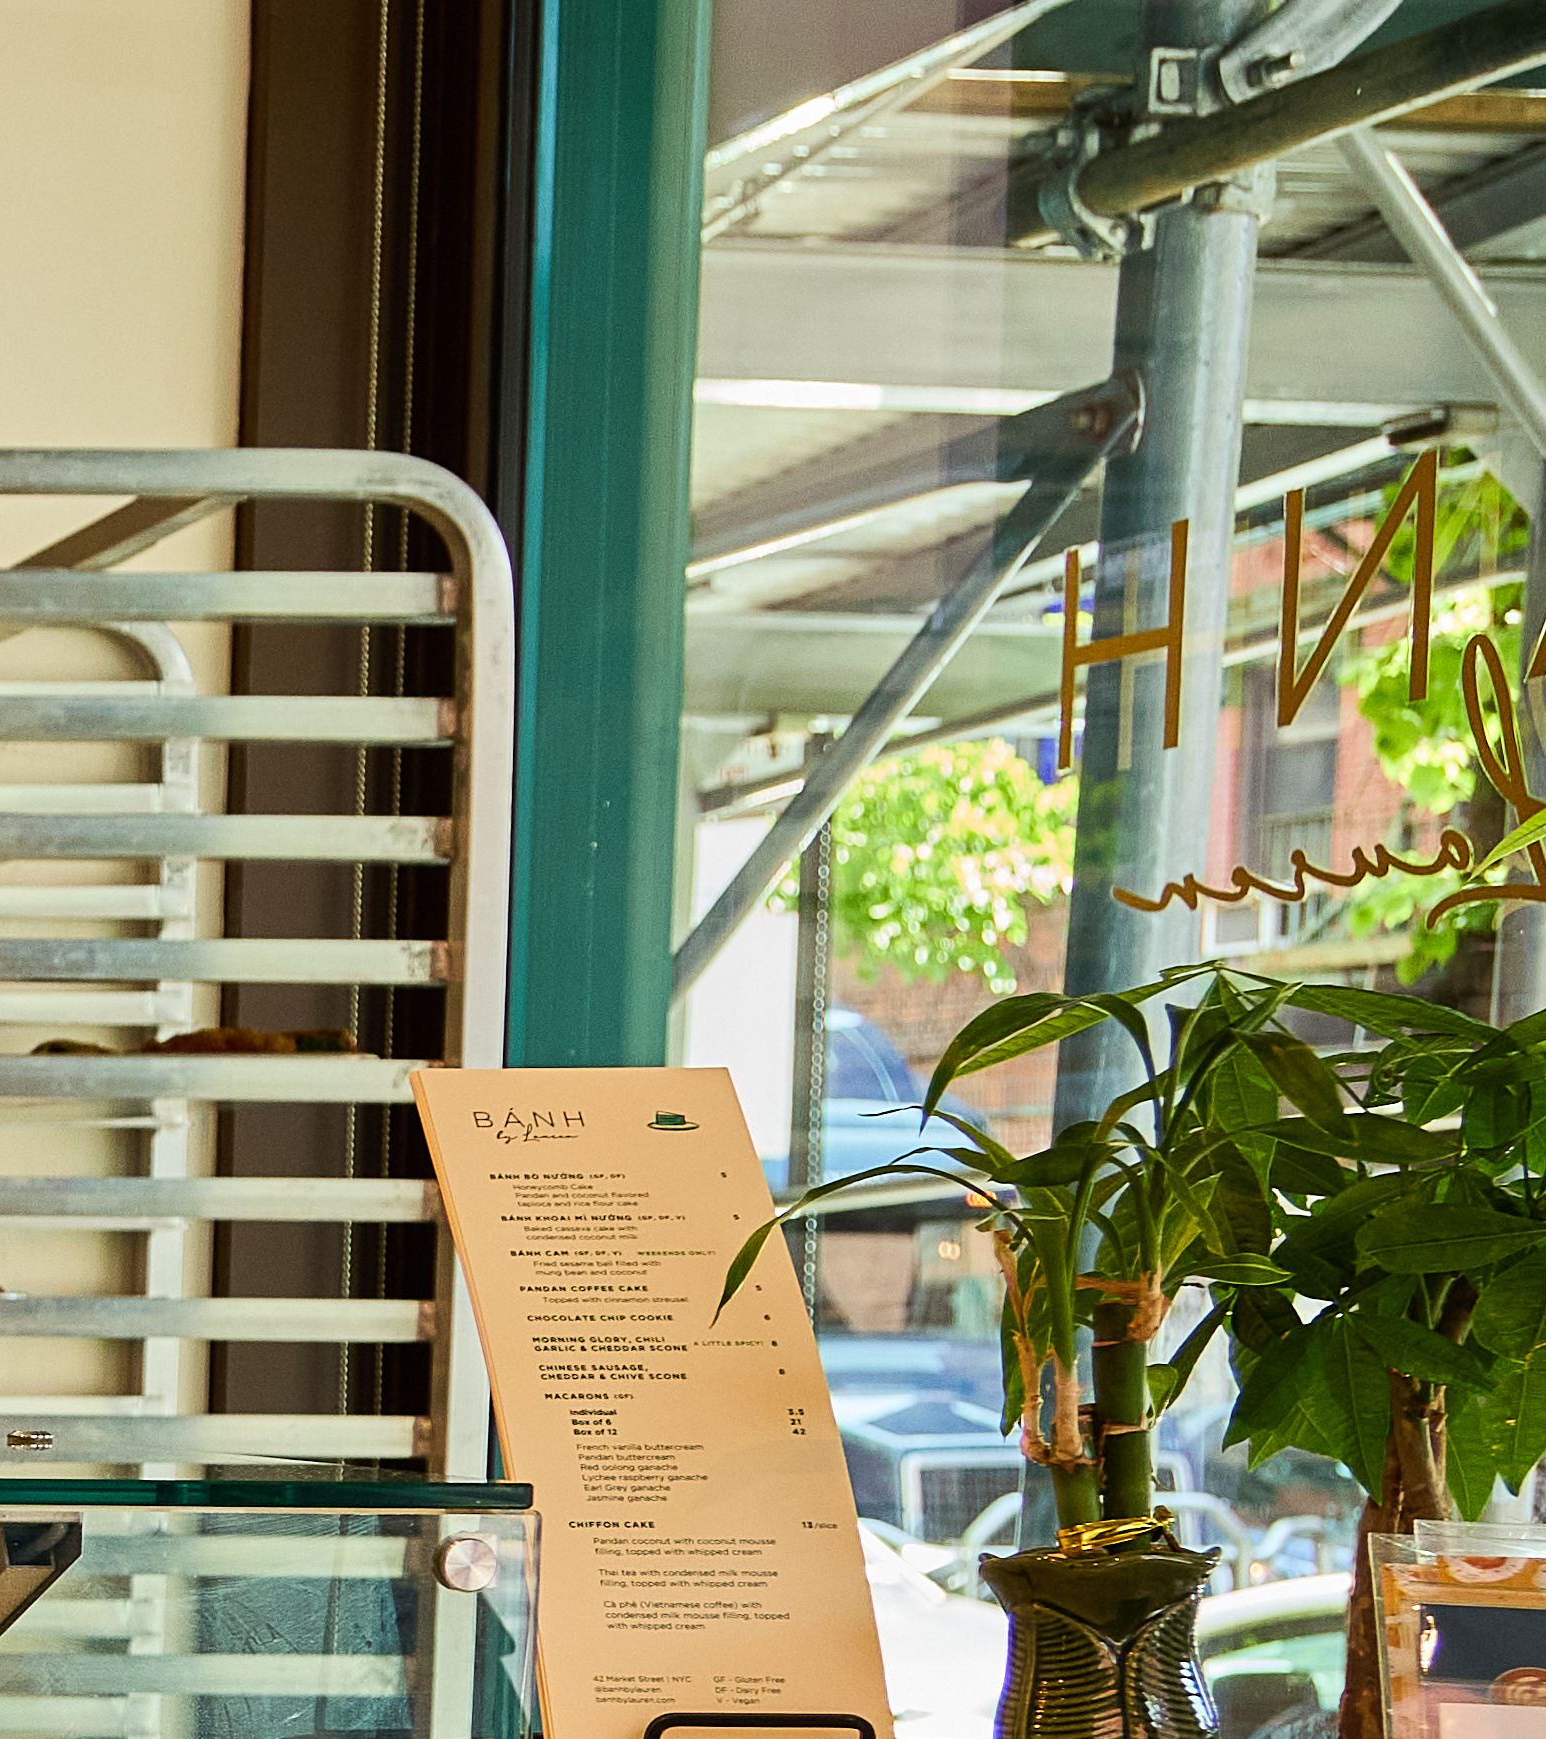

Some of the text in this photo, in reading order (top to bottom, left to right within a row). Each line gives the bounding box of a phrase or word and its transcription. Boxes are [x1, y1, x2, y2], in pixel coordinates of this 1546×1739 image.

[570, 1284, 615, 1292] COFFEE
[617, 1284, 649, 1292] CAKE
[526, 1313, 674, 1322] CHOCOLATE CHIP COOKIE
[531, 1335, 665, 1344] MORNING GLORY, CHILI
[533, 1344, 576, 1352] GARLIC
[590, 1344, 646, 1352] CHEDDAR
[649, 1343, 688, 1352] SCONE
[538, 1363, 649, 1372] CHINESE SAUSAGE,
[540, 1372, 595, 1380] CHEDDAR
[609, 1372, 645, 1380] CHIVE
[648, 1372, 687, 1380] SCONE
[544, 1392, 610, 1400] MACARONS
[569, 1408, 617, 1416] Individual
[571, 1418, 590, 1426] Box
[592, 1417, 603, 1426] of
[573, 1428, 592, 1436] Box
[594, 1427, 605, 1436] of
[568, 1520, 655, 1529] CHIFFON CAKE
